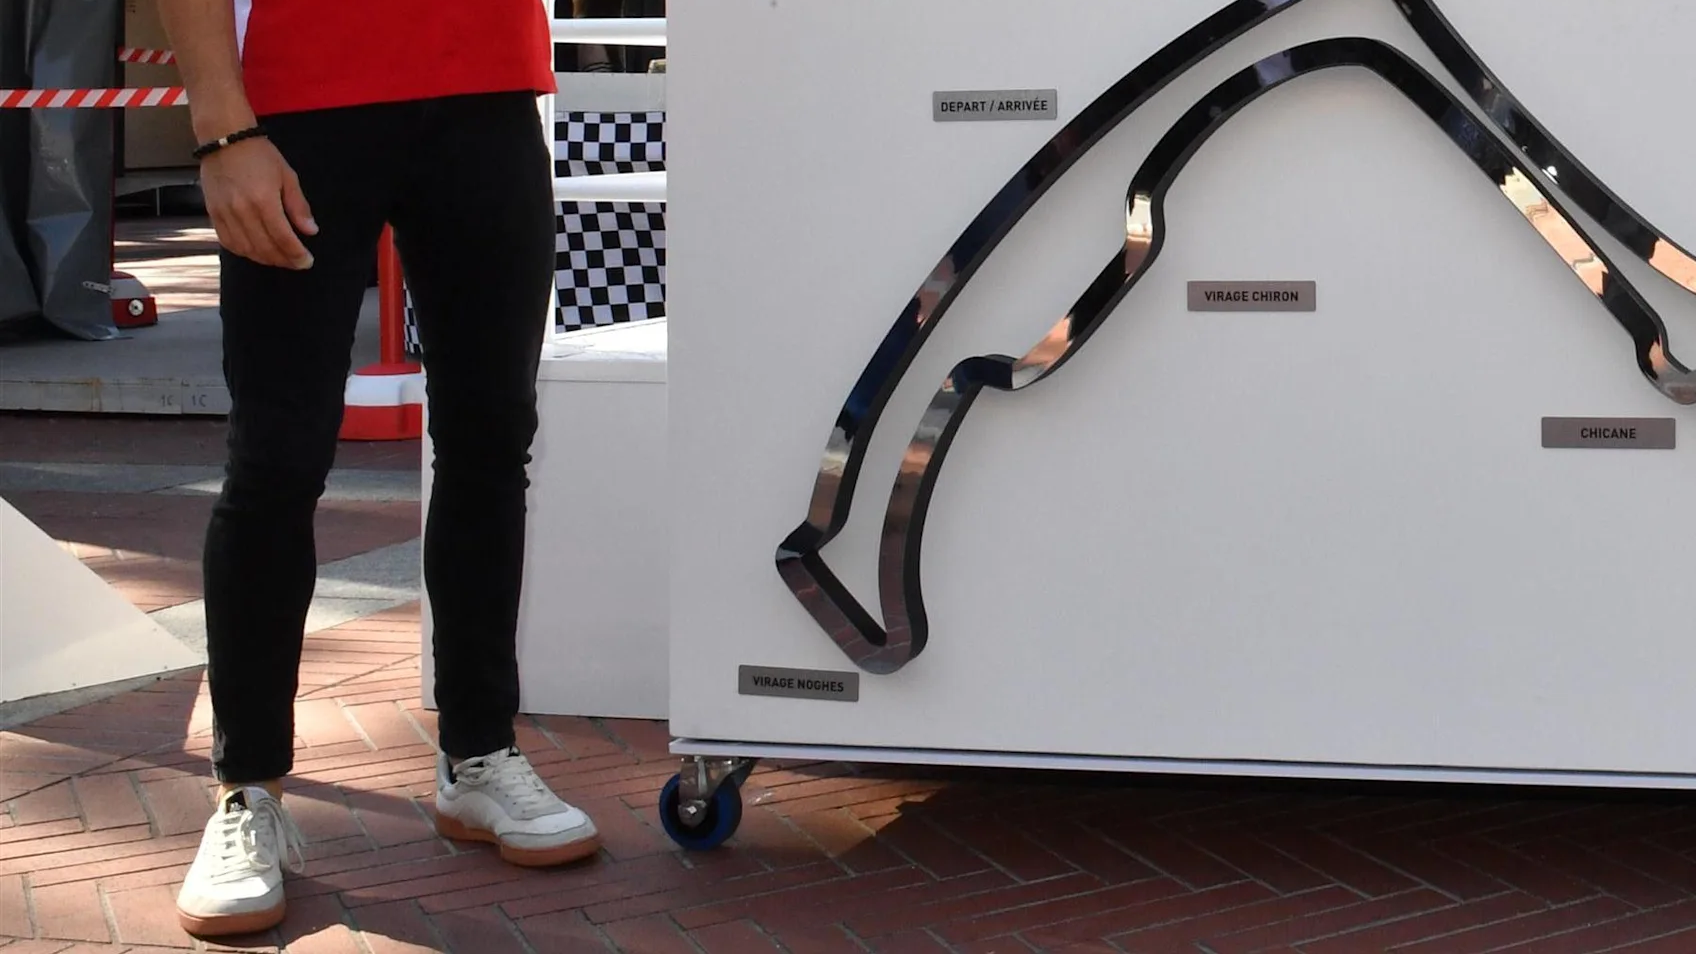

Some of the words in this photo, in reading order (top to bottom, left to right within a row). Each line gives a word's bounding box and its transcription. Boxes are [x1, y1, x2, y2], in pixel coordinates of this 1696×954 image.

[941, 101, 986, 113] DEPART
[998, 96, 1048, 112] ARRIVÉE
[1204, 290, 1249, 302] VIRAGE
[1252, 290, 1299, 302] CHIRON
[1580, 427, 1637, 439] CHICANE
[752, 675, 795, 689] VIRAGE
[797, 679, 845, 693] NOGHES
